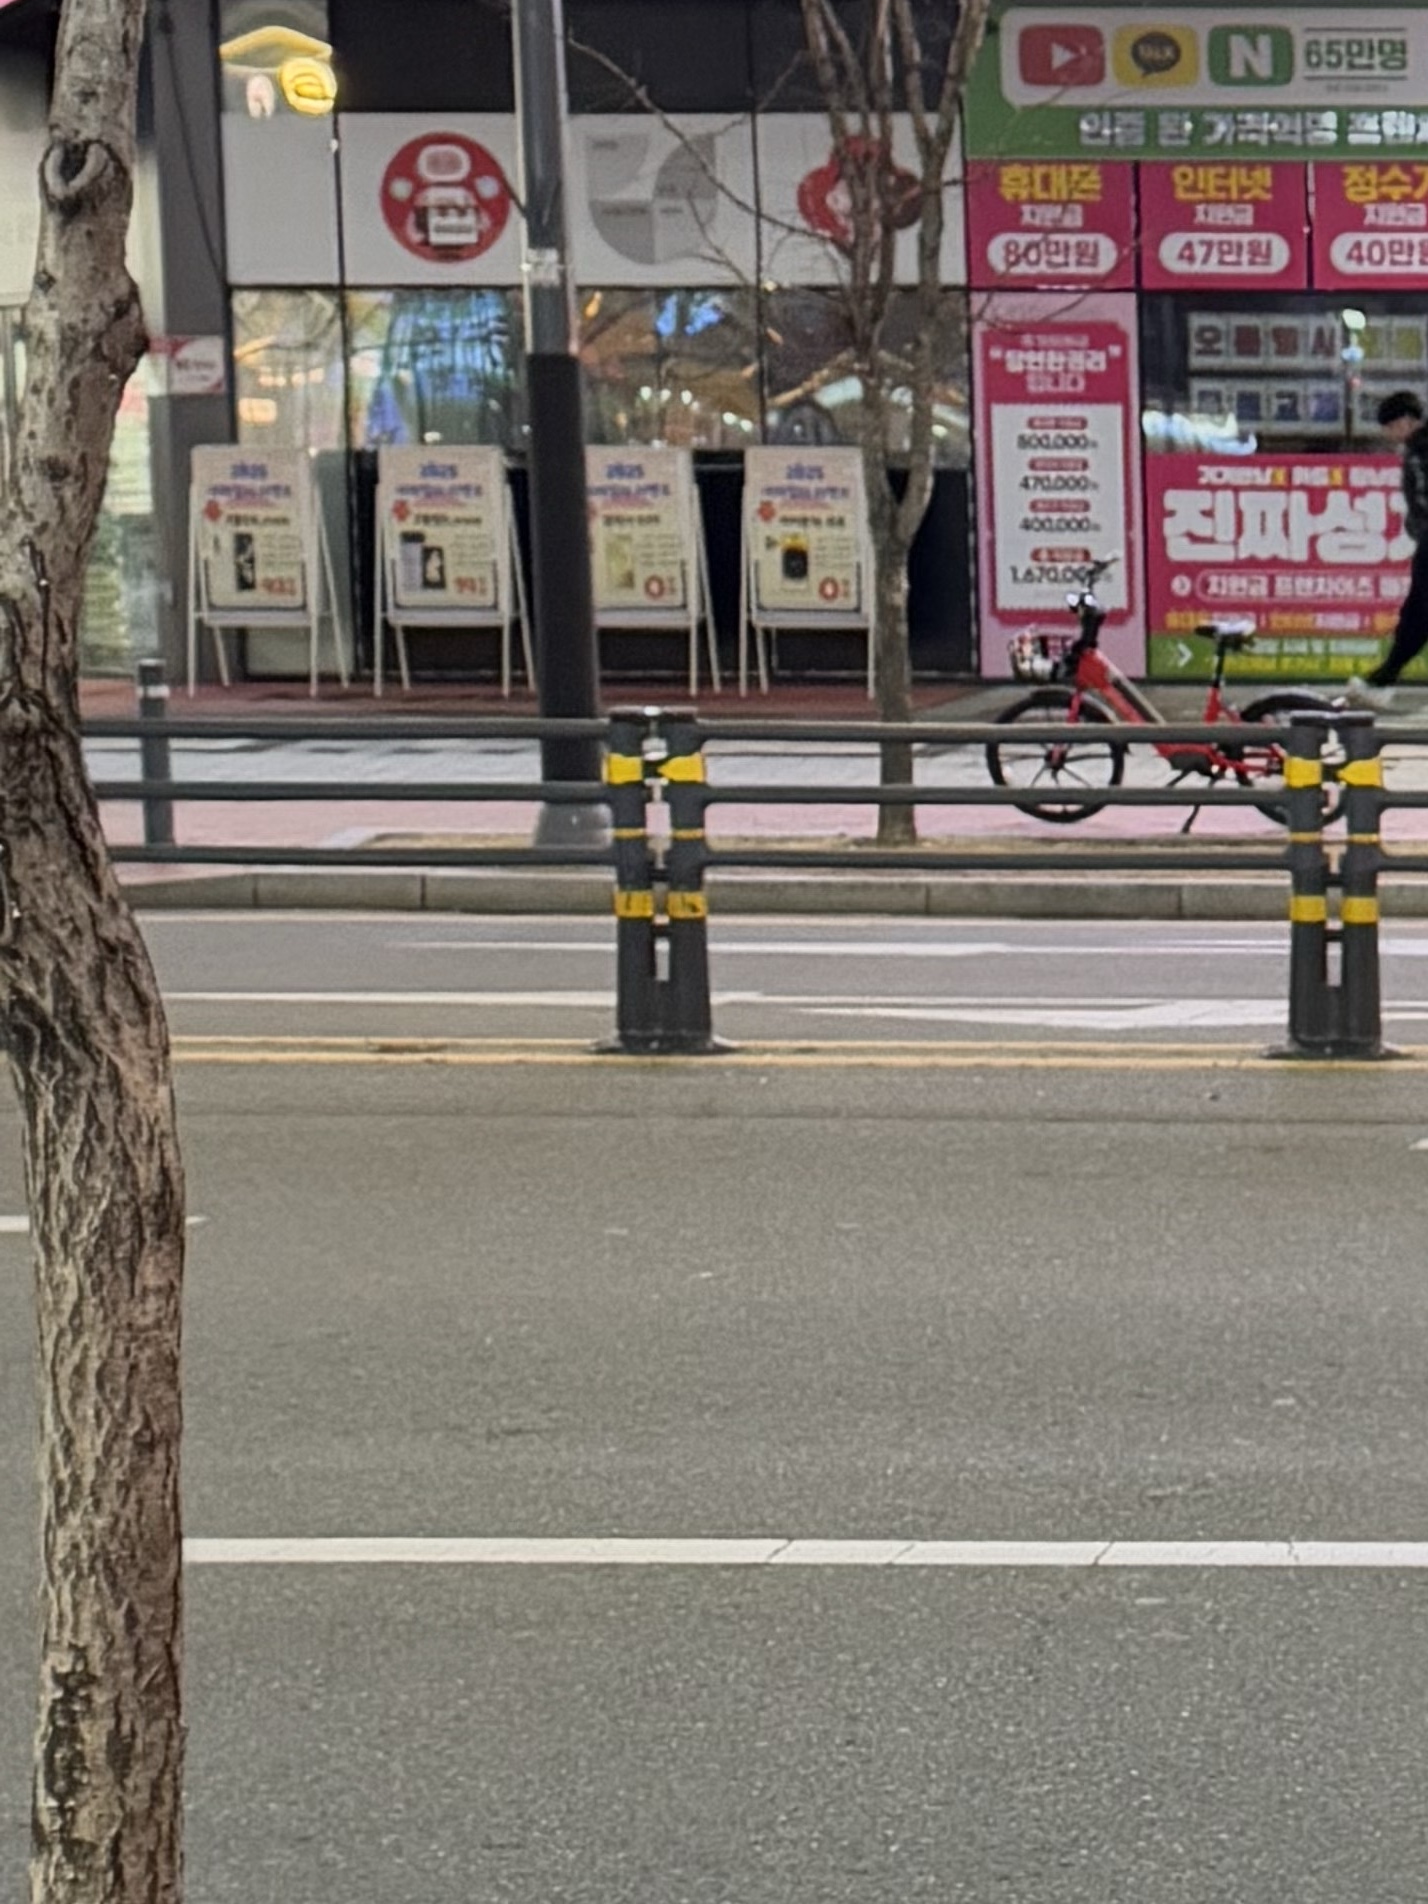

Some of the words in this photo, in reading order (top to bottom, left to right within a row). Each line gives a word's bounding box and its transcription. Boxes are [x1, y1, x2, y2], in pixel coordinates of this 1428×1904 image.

[1304, 38, 1408, 72] 65만명
[998, 164, 1102, 202] 휴대폰
[1172, 165, 1274, 202] 인터넷
[1002, 238, 1101, 268] 80만원
[1177, 239, 1274, 267] 47만원
